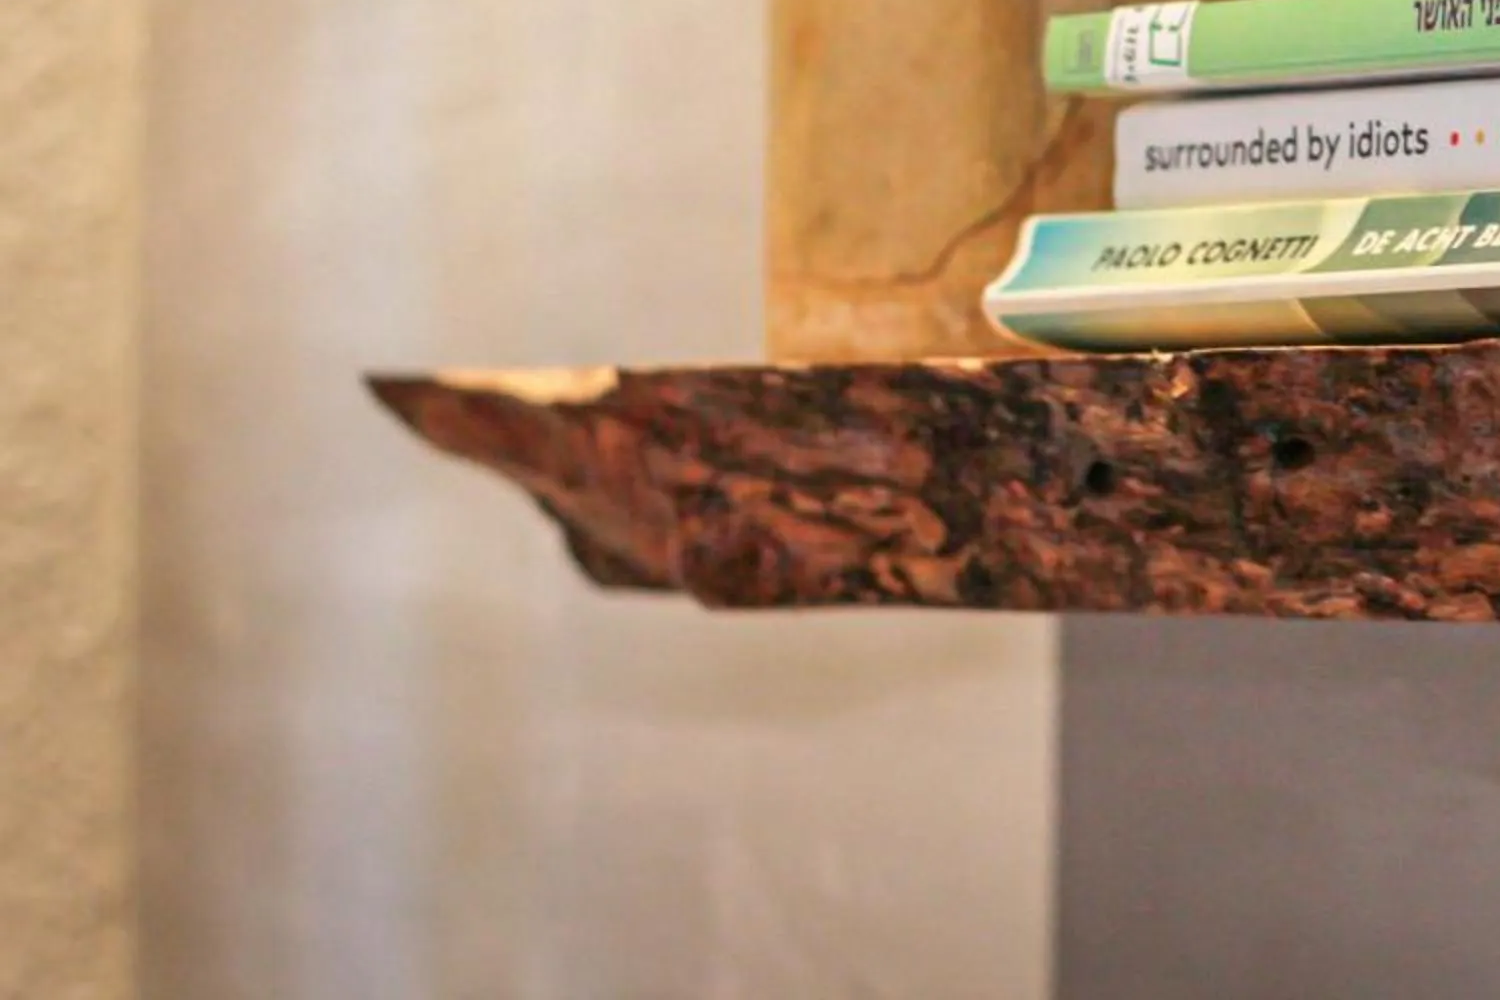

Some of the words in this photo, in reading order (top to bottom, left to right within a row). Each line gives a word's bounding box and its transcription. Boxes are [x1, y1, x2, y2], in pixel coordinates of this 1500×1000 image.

[1145, 126, 1298, 171] surrounded
[1307, 126, 1341, 170] by
[1348, 120, 1429, 159] idiots
[1092, 241, 1182, 271] PAOLO
[1186, 235, 1318, 266] COGNETTI
[1352, 229, 1396, 256] DE
[1398, 223, 1475, 253] ACHT
